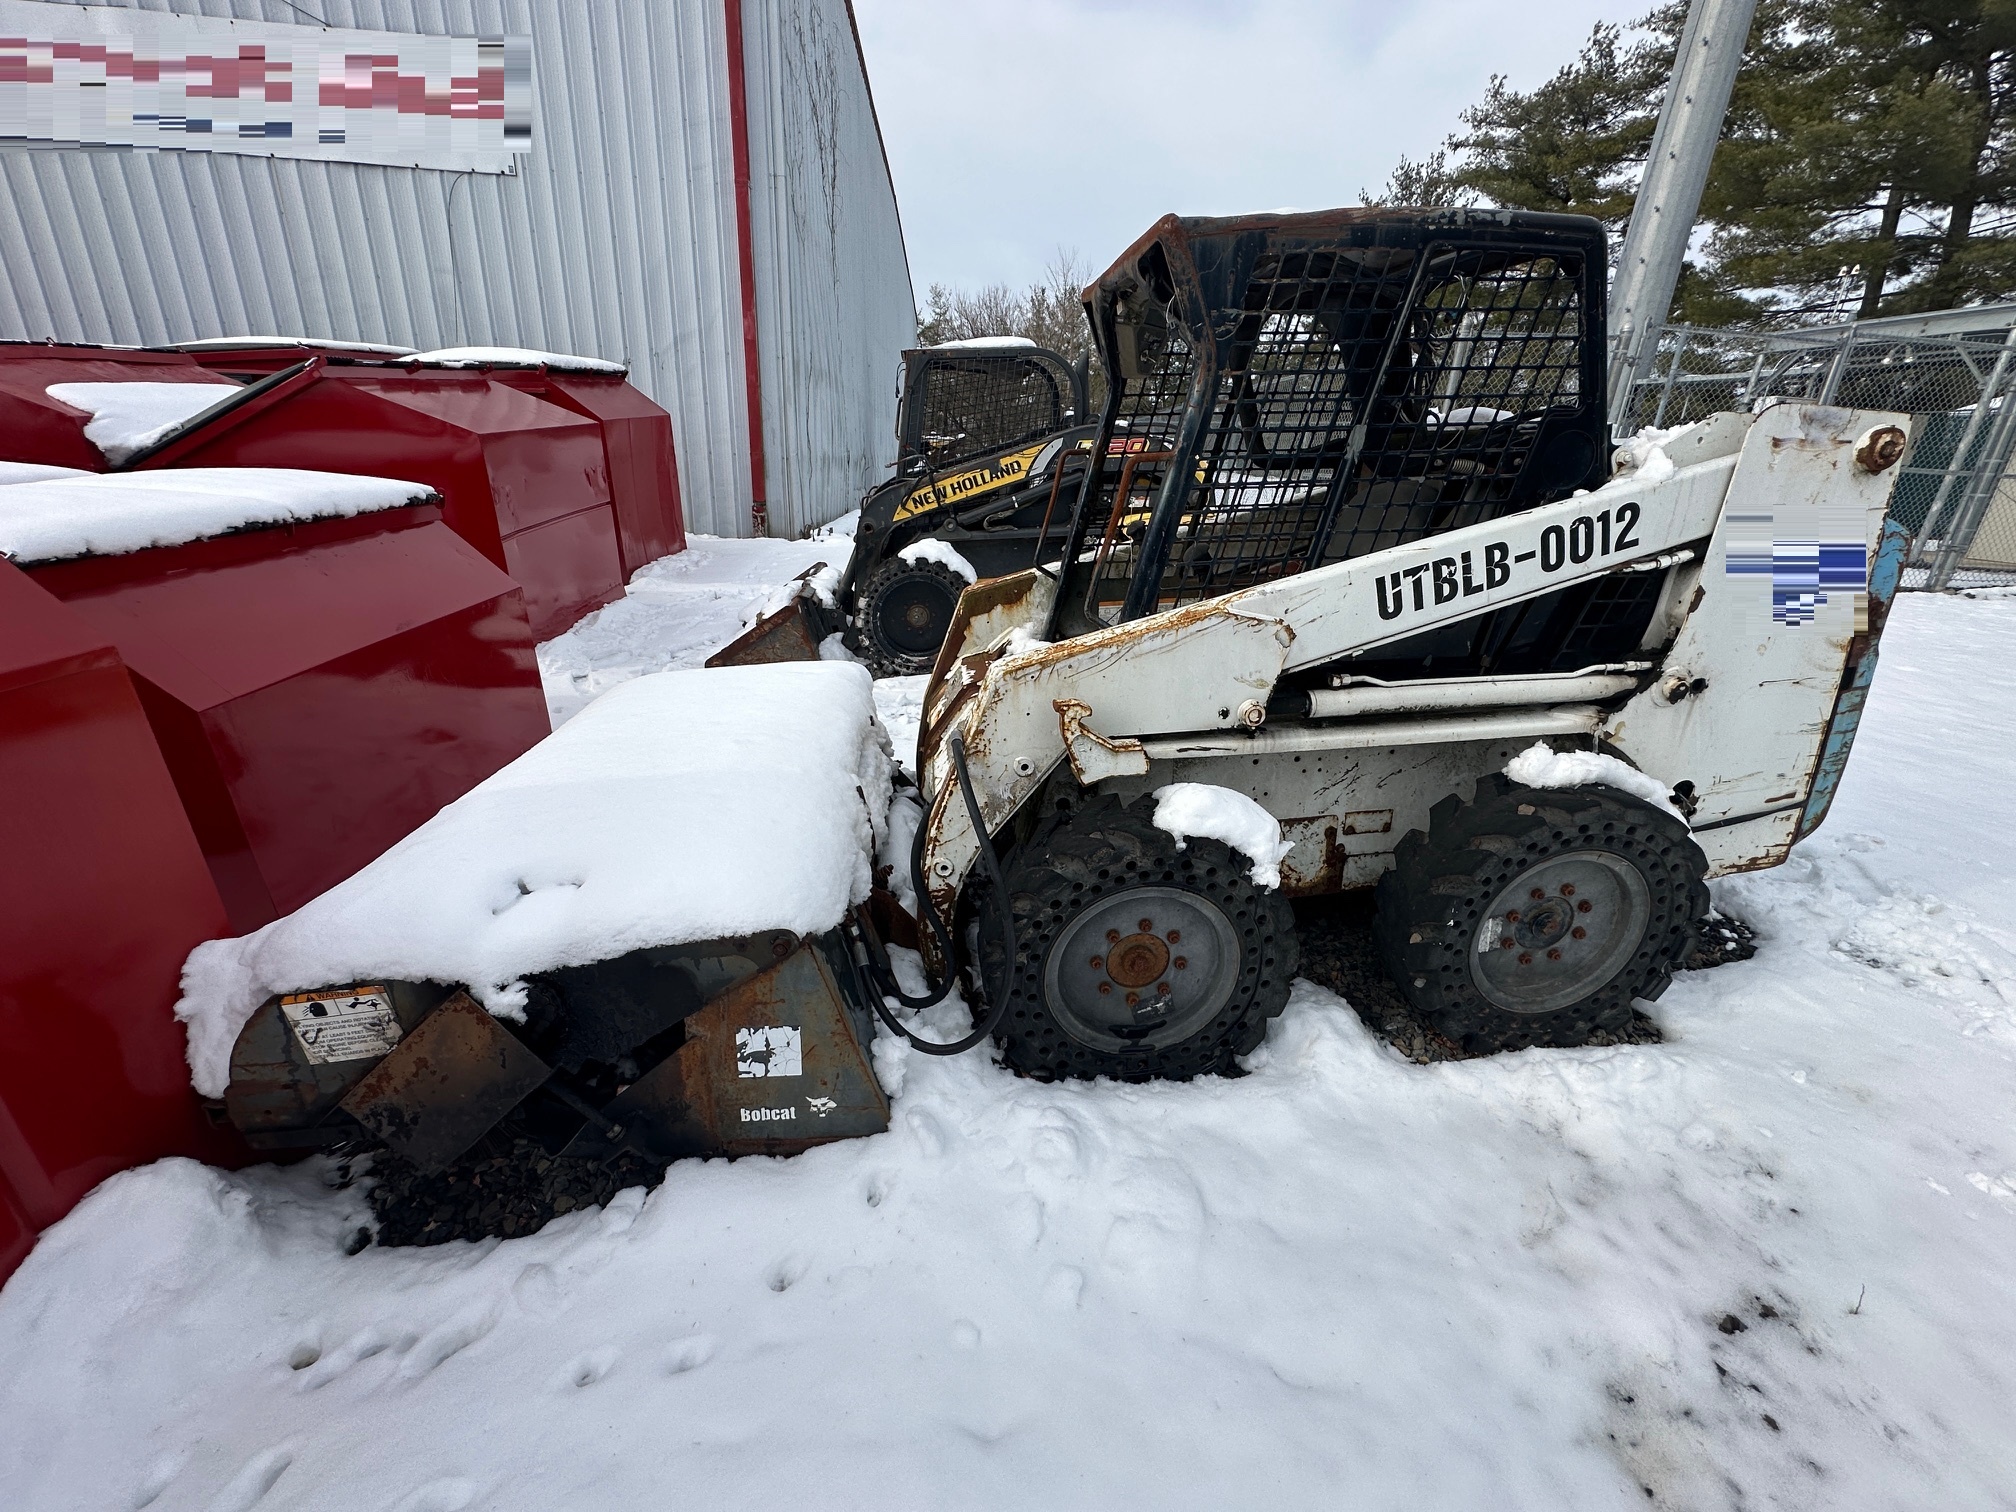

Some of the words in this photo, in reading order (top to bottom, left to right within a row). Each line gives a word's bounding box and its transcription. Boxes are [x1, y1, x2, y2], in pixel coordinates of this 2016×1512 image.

[911, 485, 947, 509] NEW
[952, 460, 1022, 496] HOLLAND
[1375, 502, 1641, 621] UTBLB-0012
[315, 990, 360, 1000] WARNING
[328, 1023, 347, 1031] CAUSE
[329, 1030, 346, 1038] LEAST
[740, 1106, 797, 1121] Bobcat
